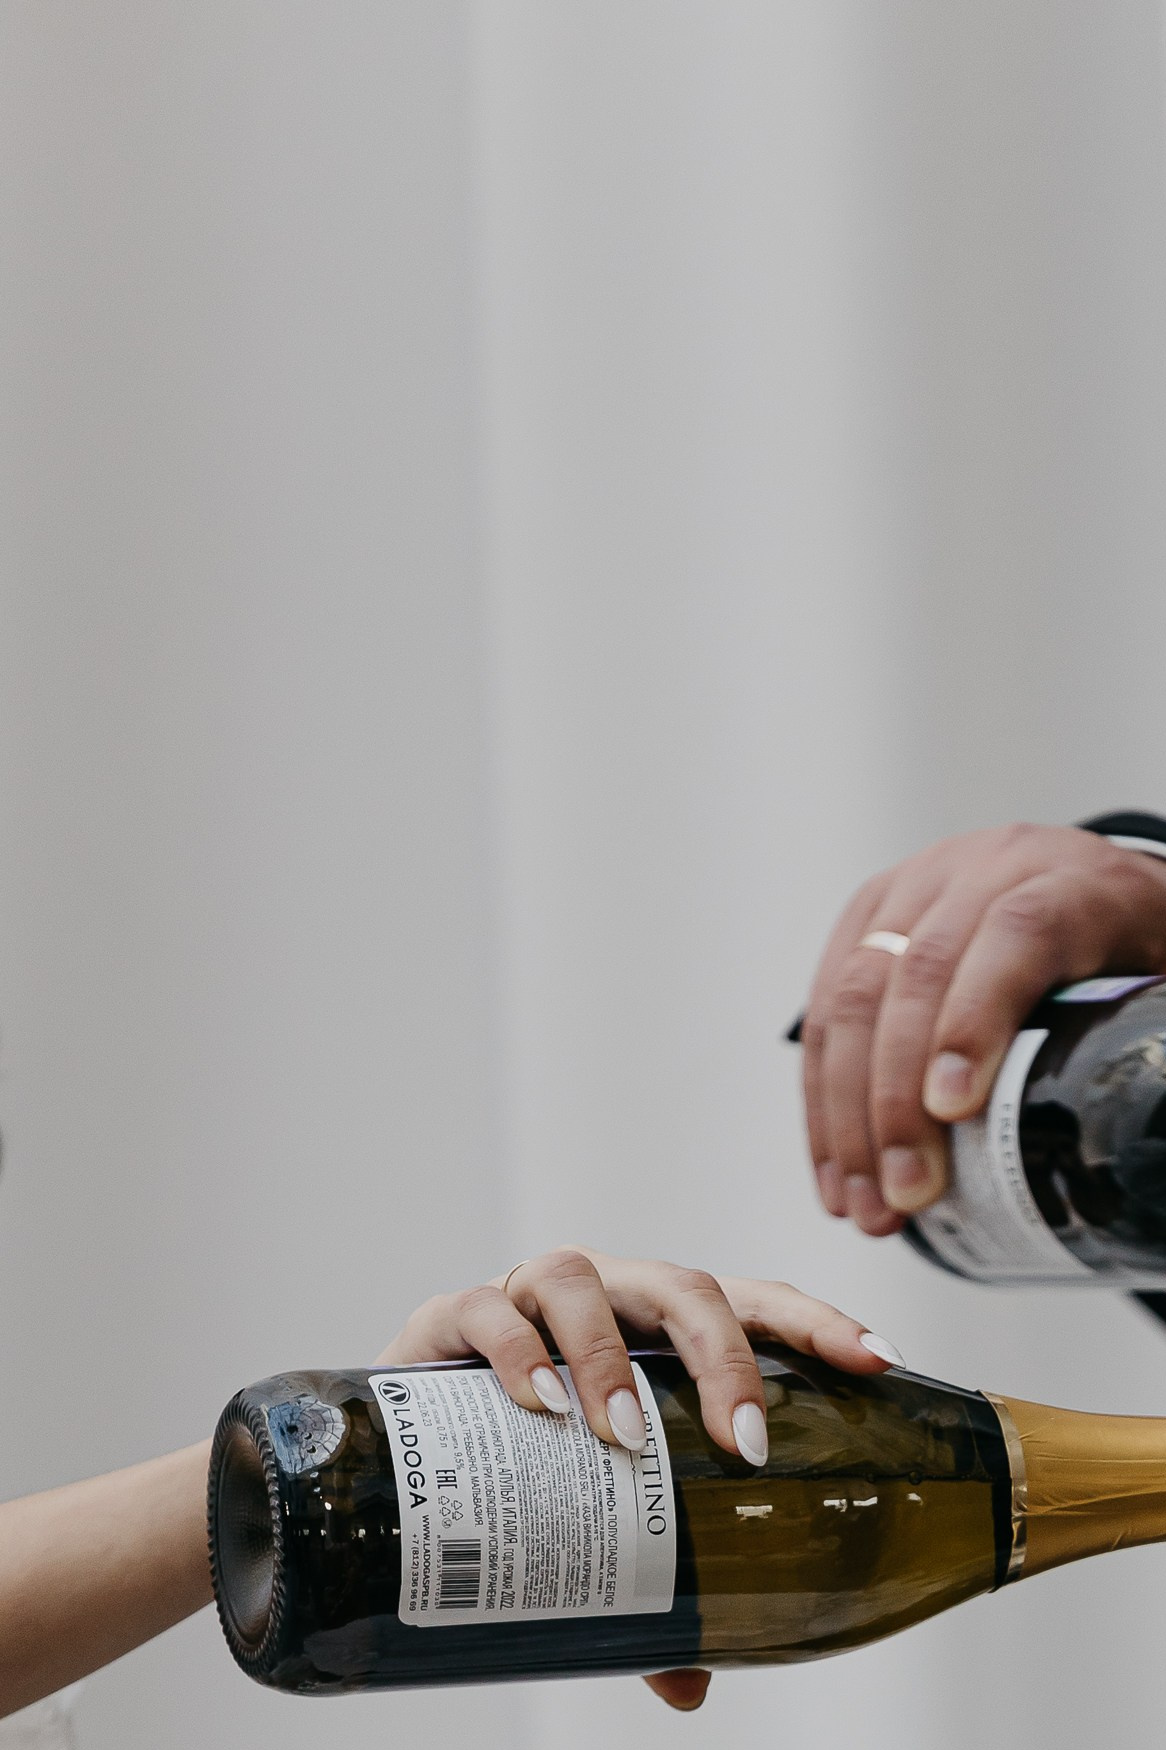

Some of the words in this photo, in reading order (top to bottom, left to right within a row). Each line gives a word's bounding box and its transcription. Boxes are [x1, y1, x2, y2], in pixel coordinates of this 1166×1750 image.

[393, 1408, 428, 1509] LADOGA
[474, 1423, 491, 1462] ОГРАНИЧЕН
[482, 1464, 493, 1478] ПРИ
[498, 1468, 515, 1505] АПУЛЬЯ,
[485, 1480, 498, 1533] СОБЛЮДЕНИИ
[502, 1507, 518, 1546] ИТАЛИЯ.
[411, 1547, 419, 1569] (812)
[420, 1515, 431, 1611] WWW.LADOGASPB.RU
[488, 1535, 500, 1570] УСЛОВИЙ
[502, 1548, 514, 1561] ГОД
[606, 1515, 618, 1579] ПОЛУСЛАДКОЕ
[409, 1601, 417, 1611] 69
[411, 1589, 418, 1599] 96
[485, 1572, 498, 1611] ХРАНЕНИЯ.
[603, 1581, 616, 1608] БЕЛОЕ
